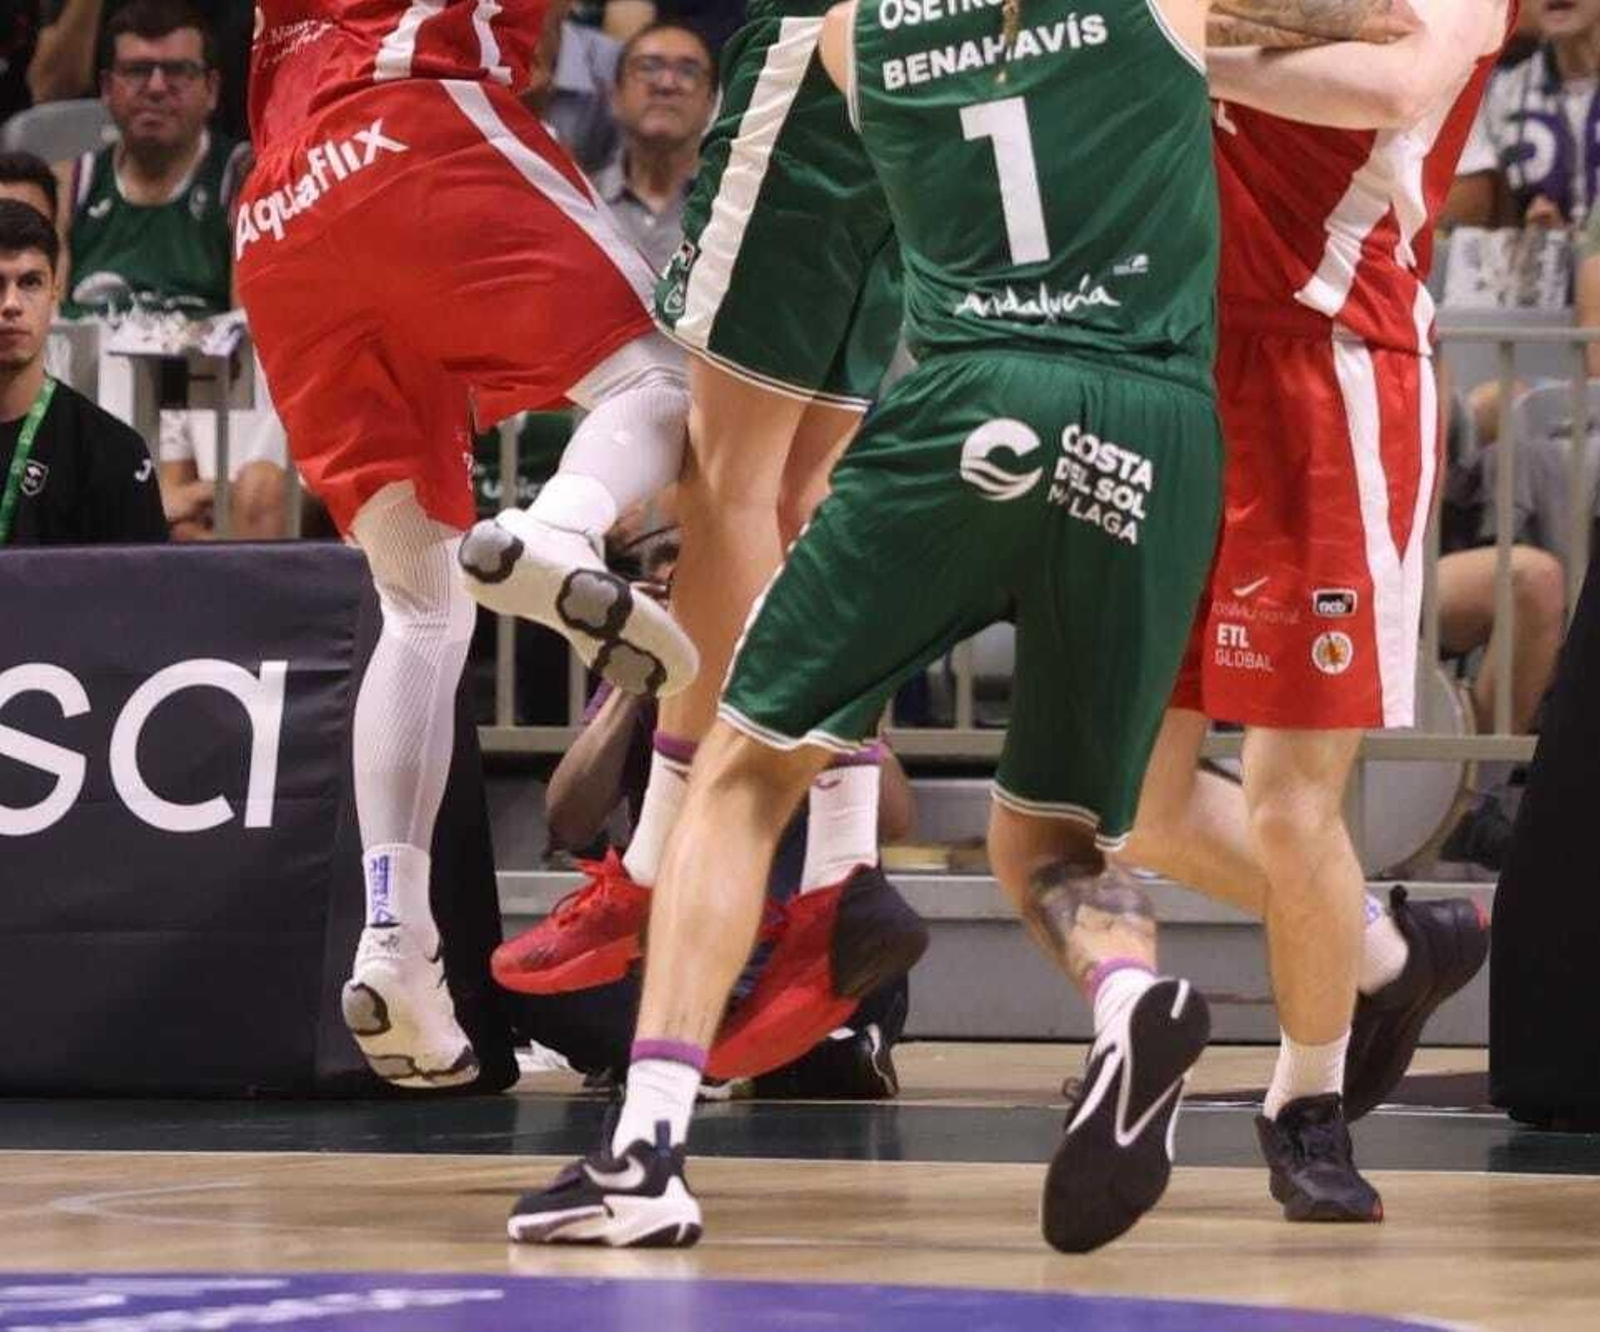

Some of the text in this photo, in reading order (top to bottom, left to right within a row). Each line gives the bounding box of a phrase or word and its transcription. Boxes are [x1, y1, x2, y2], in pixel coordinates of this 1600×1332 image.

[882, 12, 1108, 90] BENAHAVÍS
[959, 99, 1050, 266] 1
[1061, 424, 1153, 493] COSTA
[1094, 477, 1146, 520] SOL
[1214, 647, 1274, 672] GLOBAL
[1216, 623, 1250, 648] ETL
